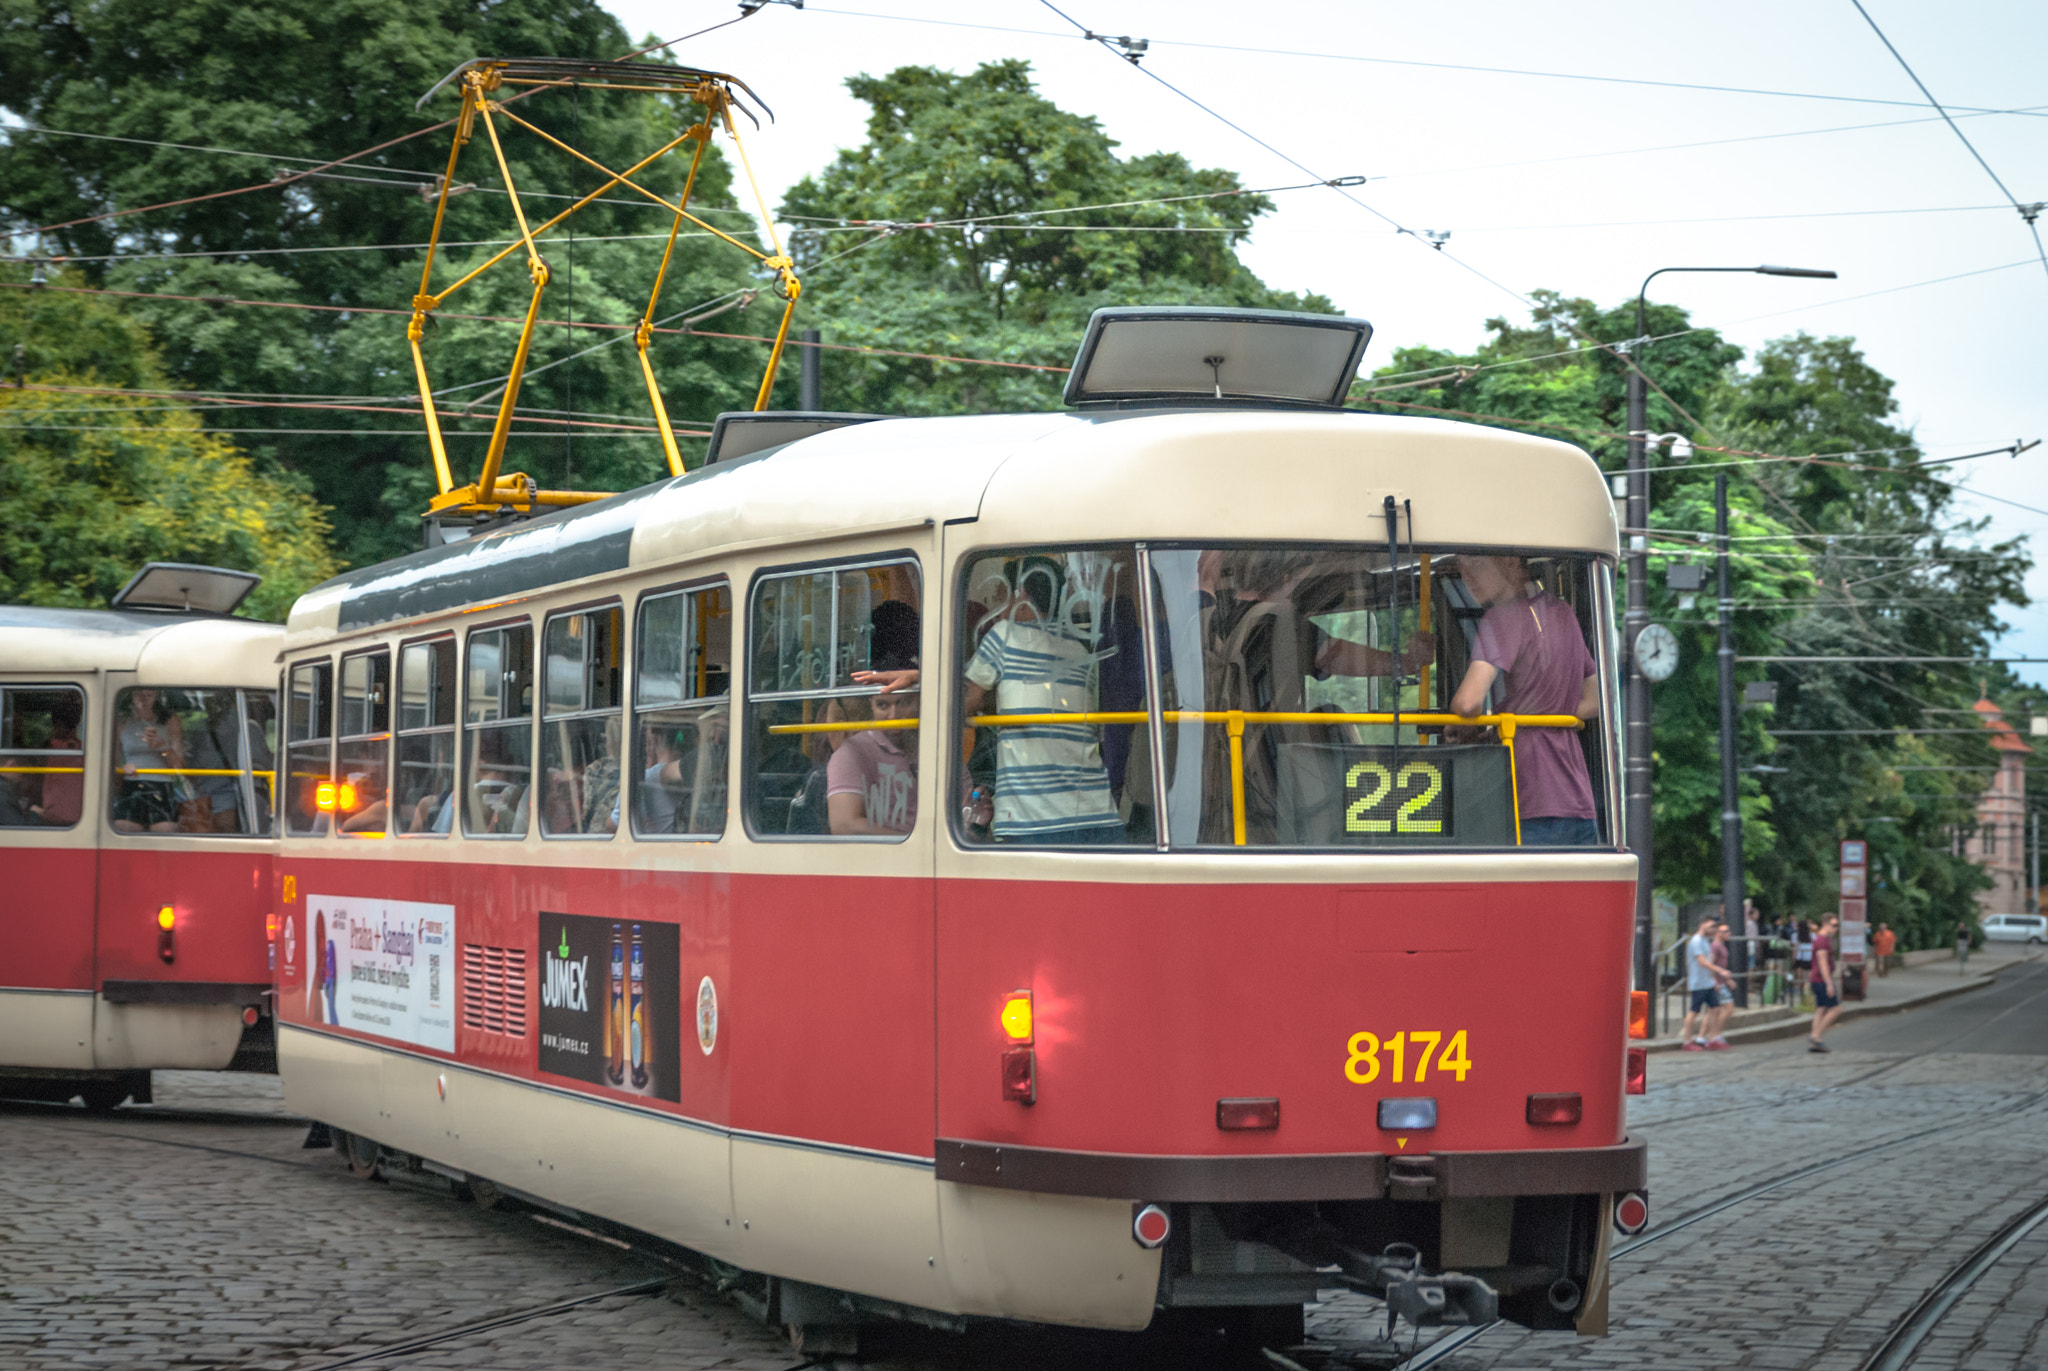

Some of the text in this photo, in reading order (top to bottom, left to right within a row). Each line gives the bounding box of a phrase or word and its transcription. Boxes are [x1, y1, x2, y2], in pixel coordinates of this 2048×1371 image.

[1346, 761, 1442, 832] 22
[542, 951, 588, 1012] JUMEX
[542, 1032, 589, 1055] www.jumex.cz
[1344, 1029, 1472, 1085] 8174
